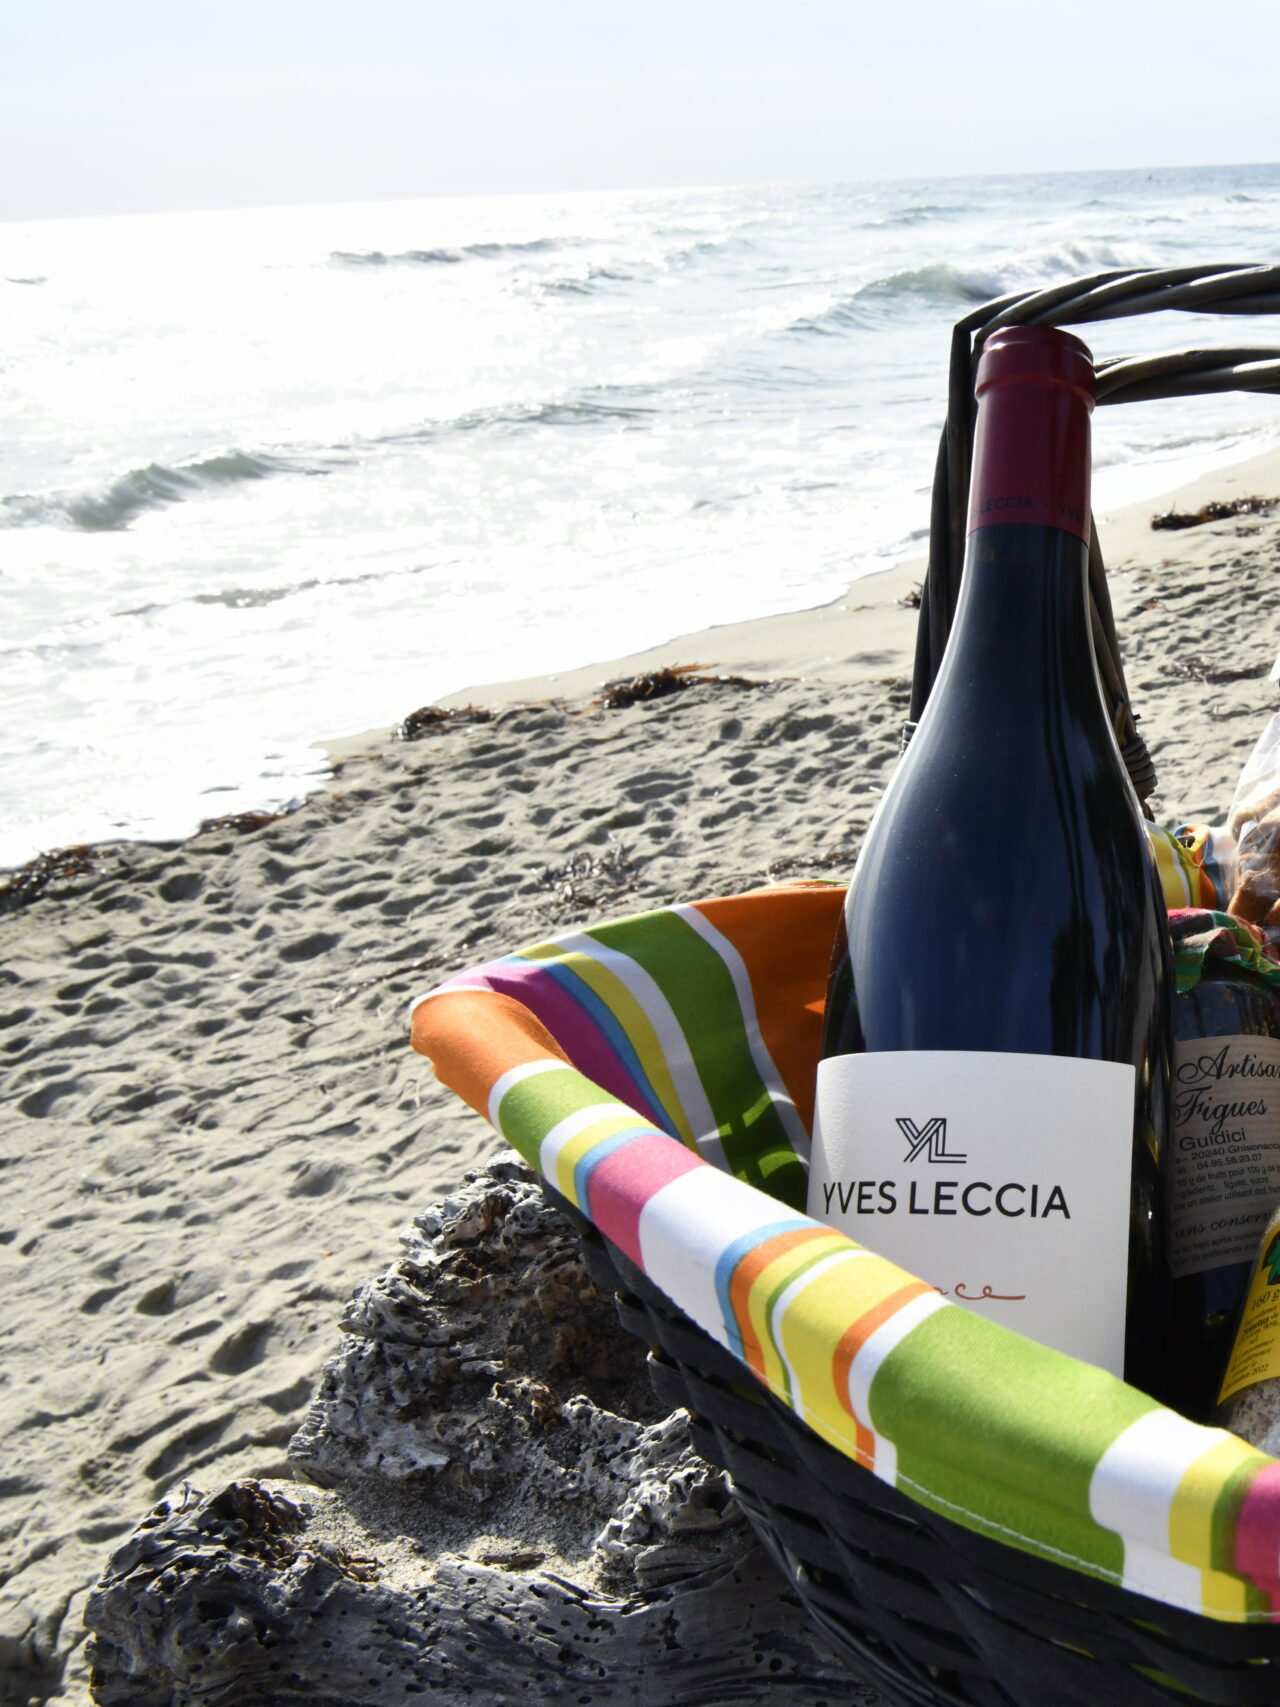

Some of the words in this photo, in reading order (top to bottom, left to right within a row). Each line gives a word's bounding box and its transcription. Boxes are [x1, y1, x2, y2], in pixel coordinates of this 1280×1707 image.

[1176, 1085, 1268, 1134] Figues
[1179, 1128, 1247, 1151] Guidici
[1191, 1147, 1225, 1160] 20240
[822, 1180, 897, 1215] YVES
[908, 1181, 1071, 1219] LECCIA
